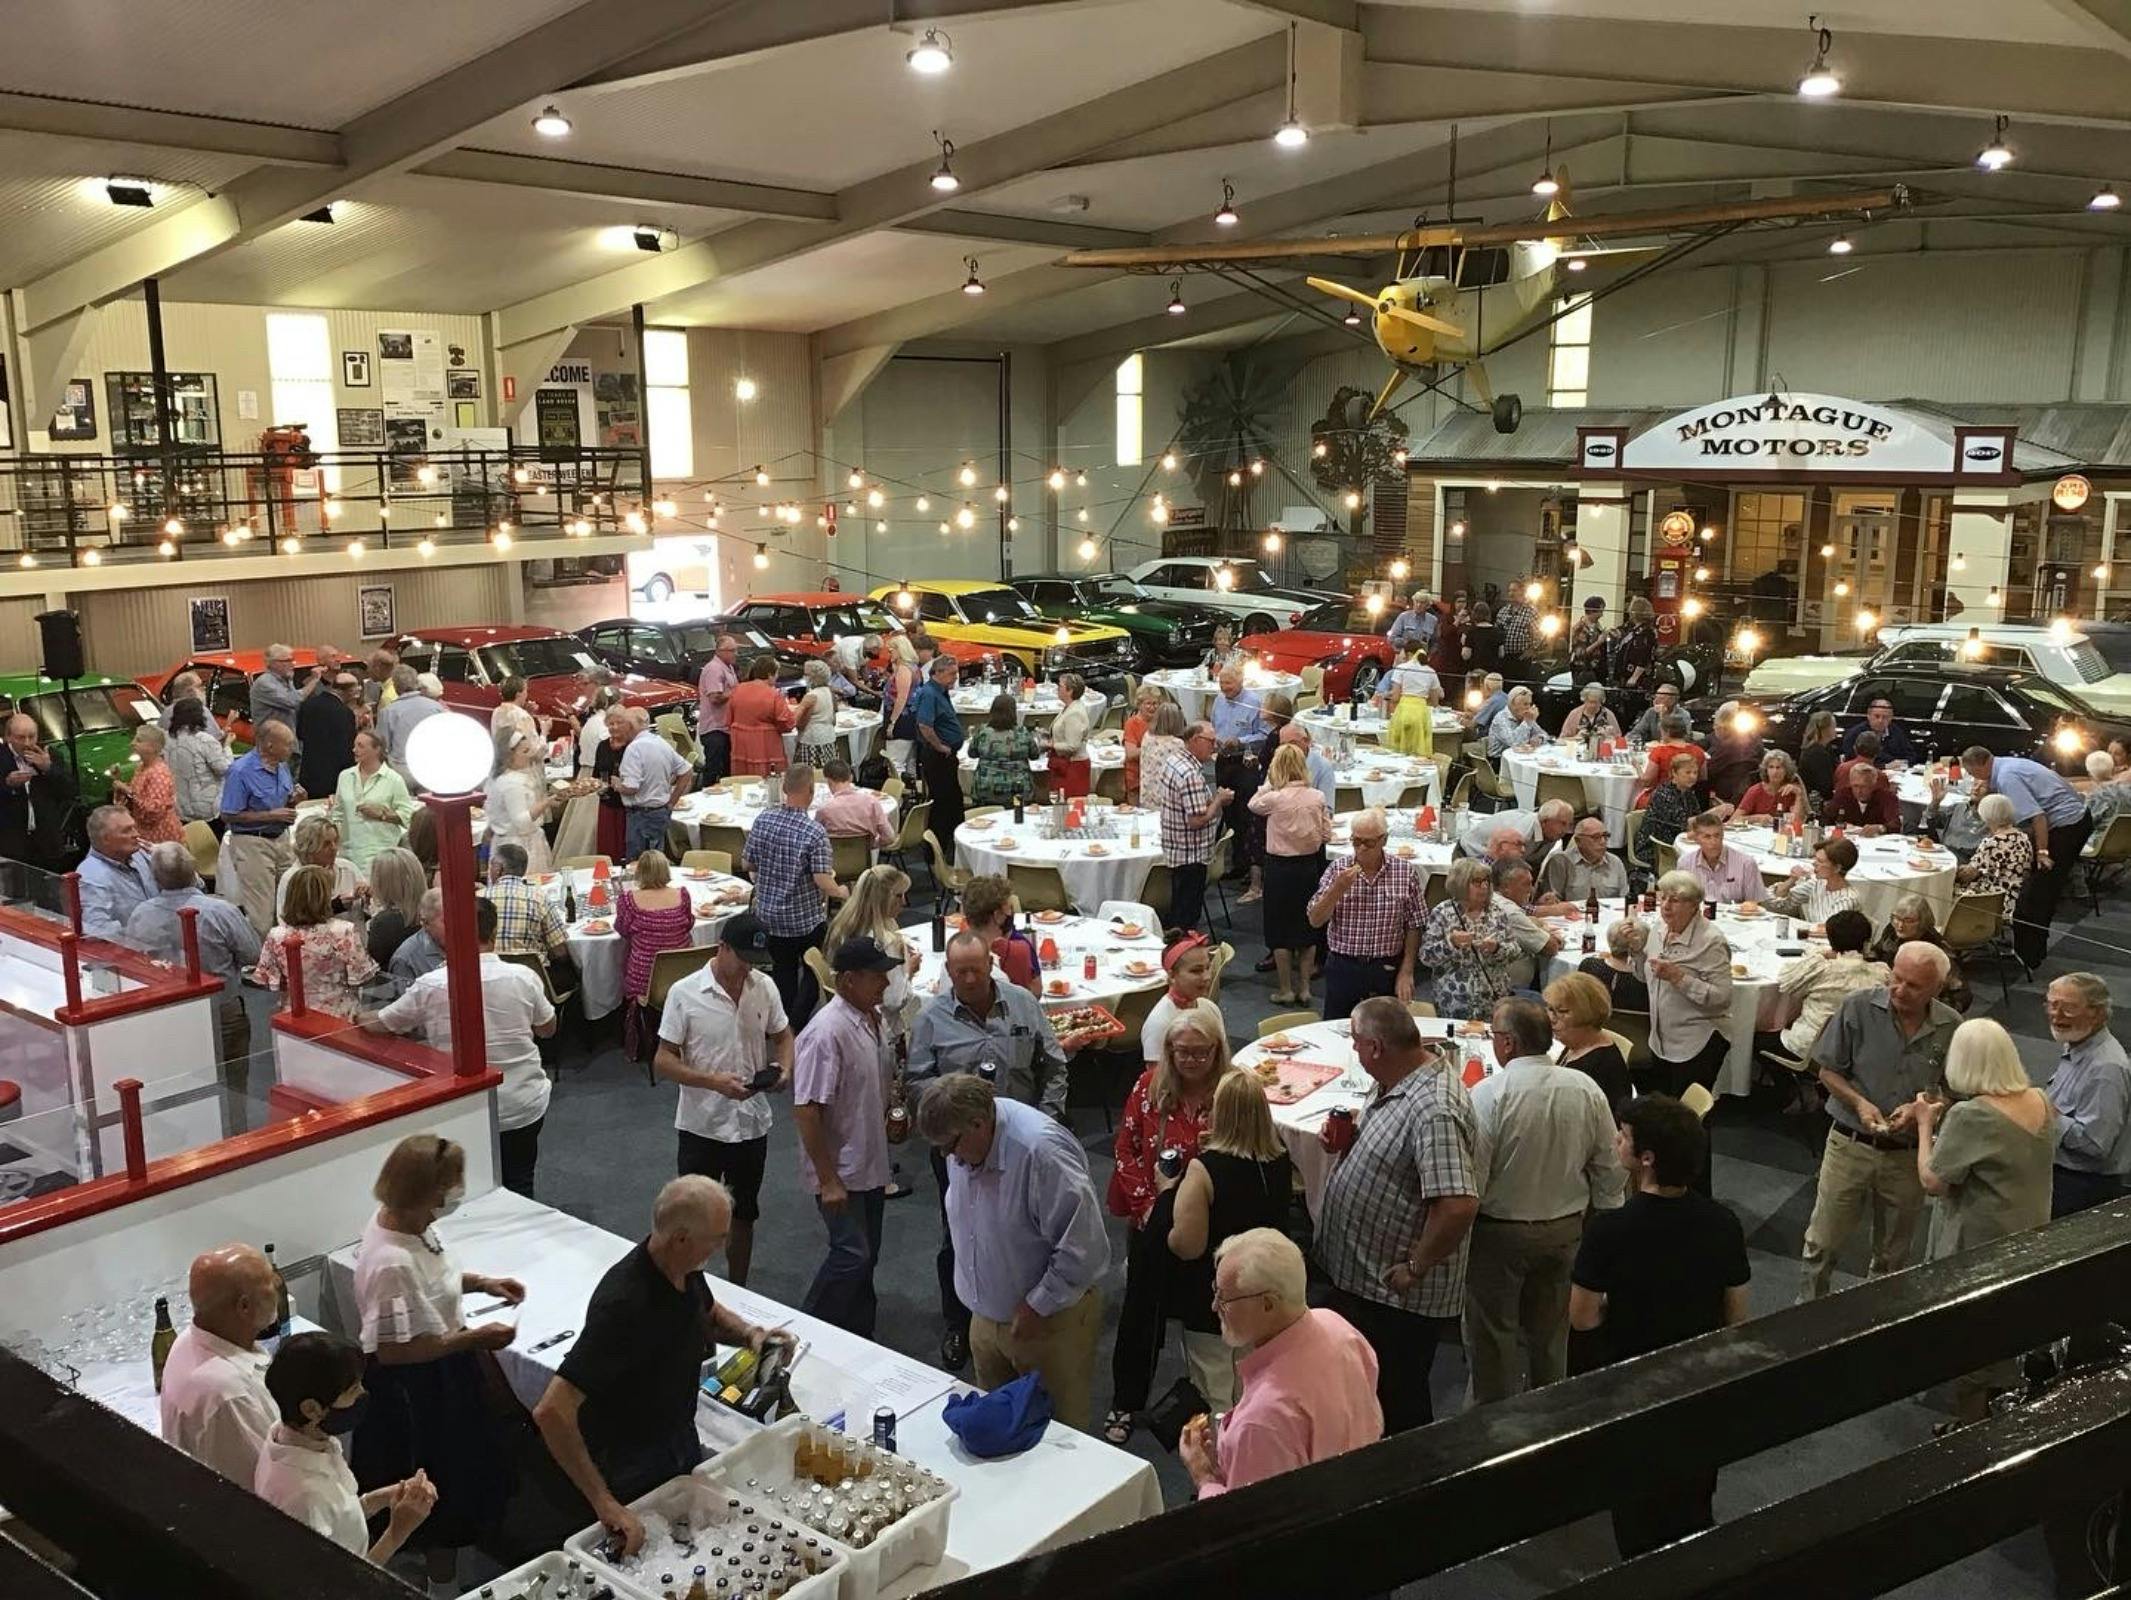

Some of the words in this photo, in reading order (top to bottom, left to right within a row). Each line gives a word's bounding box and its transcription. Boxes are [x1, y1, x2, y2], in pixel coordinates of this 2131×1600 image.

[544, 365, 590, 382] COME
[1676, 403, 1894, 442] MONTAGUE
[1701, 438, 1871, 457] MOTORS
